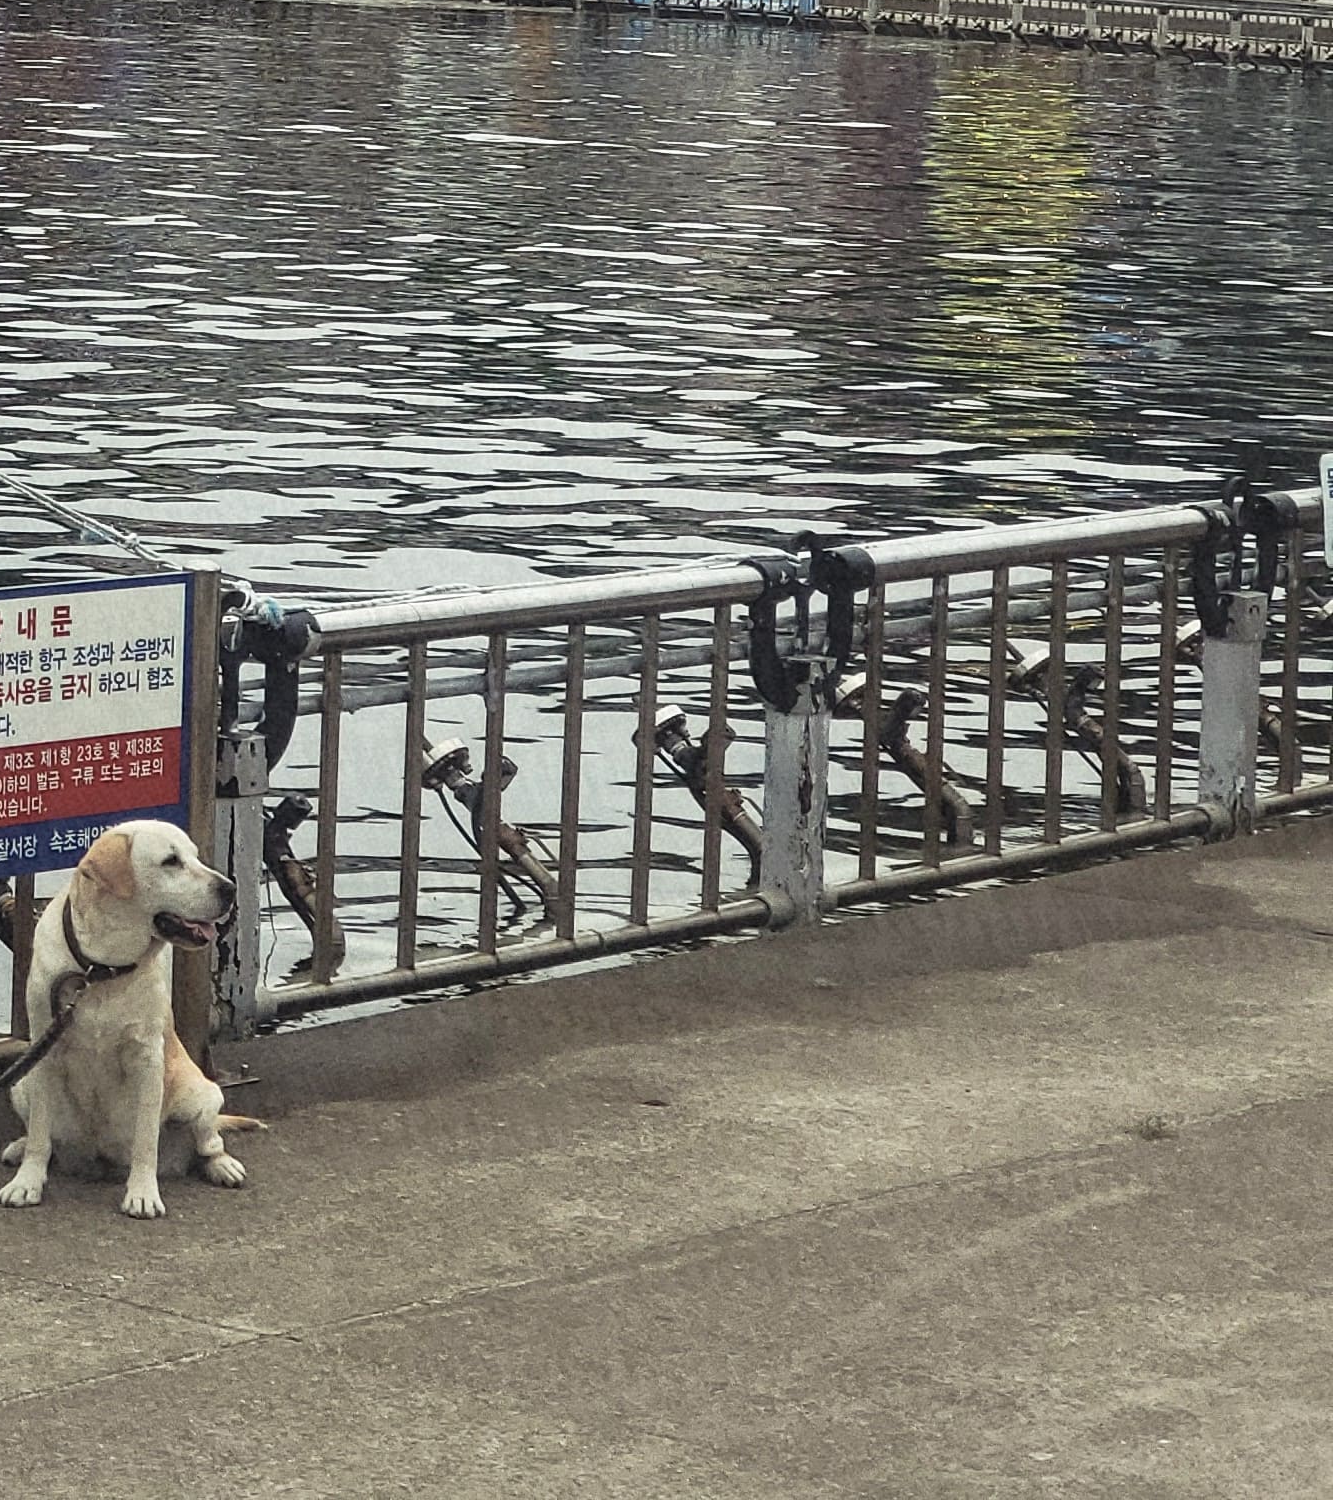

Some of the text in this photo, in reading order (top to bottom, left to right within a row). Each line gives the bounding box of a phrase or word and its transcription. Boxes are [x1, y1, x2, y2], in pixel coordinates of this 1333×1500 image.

[39, 647, 68, 672] 항구
[72, 641, 115, 667] 조성과
[120, 635, 175, 662] 소음방지
[60, 672, 92, 700] 금지
[98, 669, 140, 695] 하오니
[147, 666, 175, 690] 협조
[4, 752, 35, 772] 제3조
[40, 746, 71, 767] 제1항
[77, 742, 104, 762] 23호
[109, 740, 120, 760] 및
[126, 736, 164, 757] 제38조
[36, 771, 65, 791] 벌금,
[71, 766, 95, 787] 구류
[100, 763, 124, 781] 또는
[129, 758, 163, 778] 과료의
